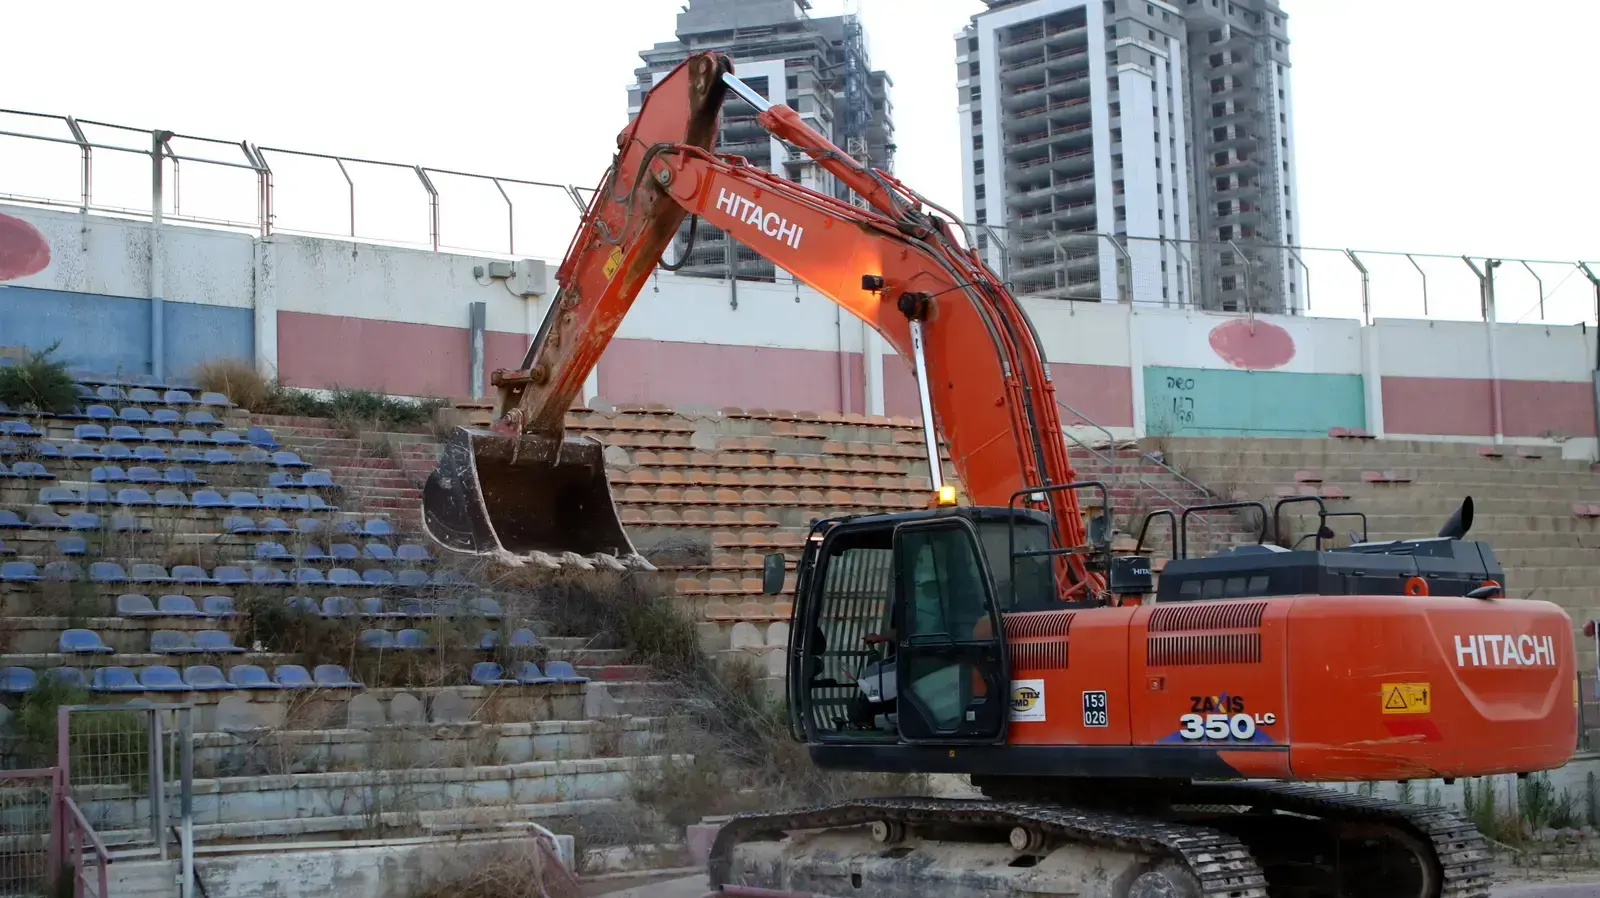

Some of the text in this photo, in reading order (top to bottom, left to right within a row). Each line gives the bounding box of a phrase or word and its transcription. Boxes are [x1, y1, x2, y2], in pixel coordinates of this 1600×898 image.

[716, 188, 803, 249] HITACHI
[1454, 635, 1555, 666] HITACHI
[1084, 694, 1105, 708] 153
[1190, 691, 1245, 713] ZAXIS
[1085, 711, 1106, 724] 026
